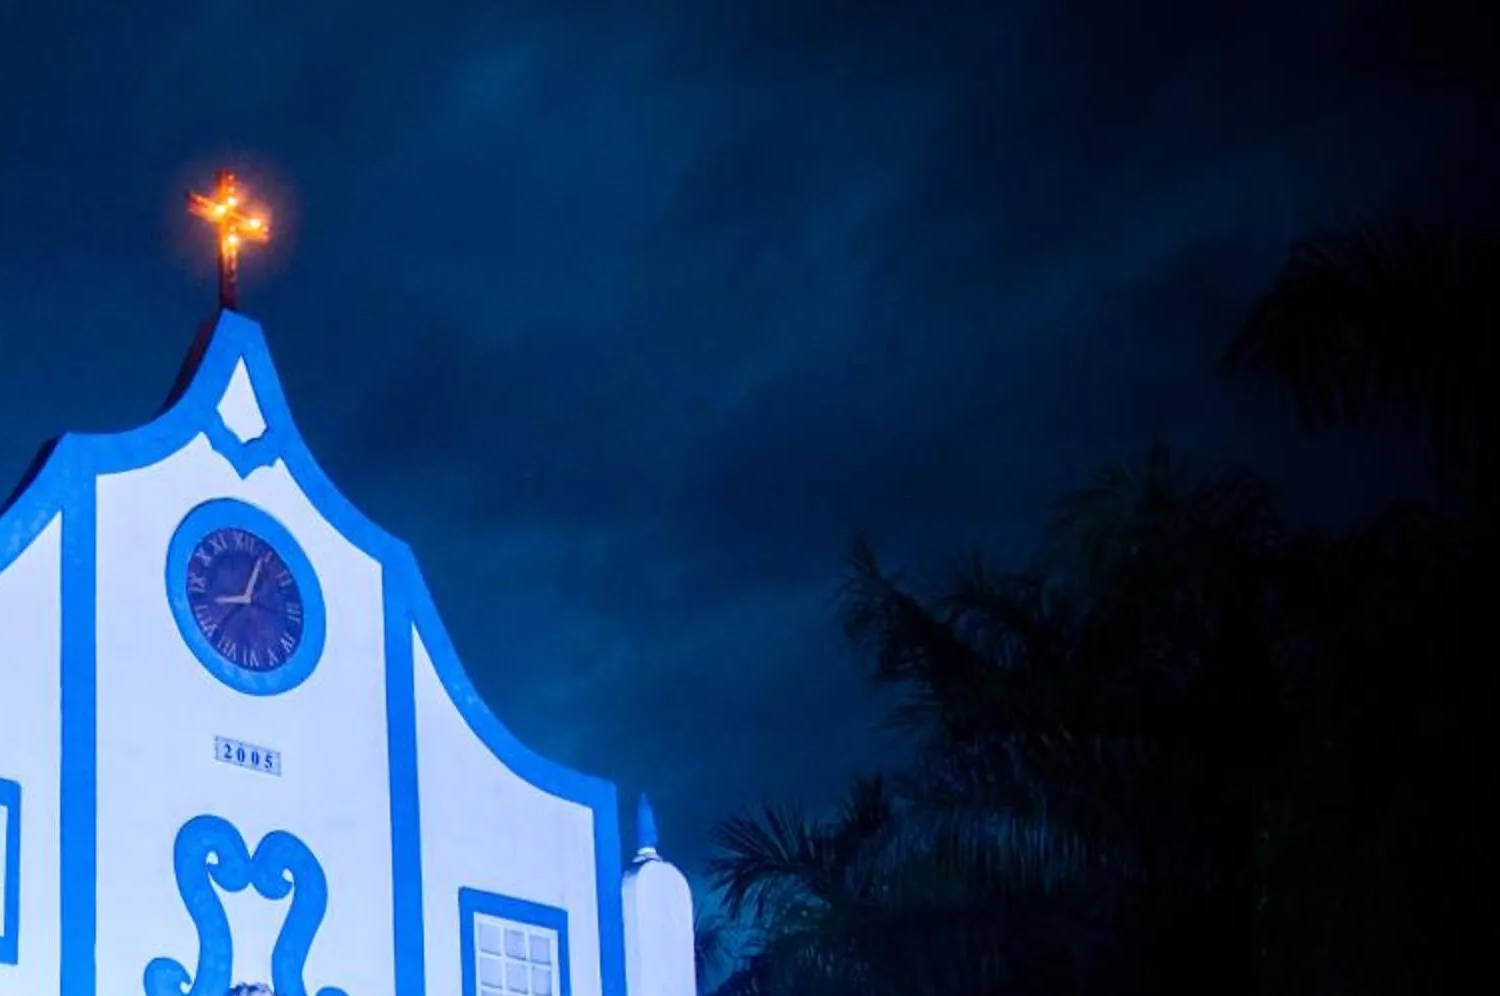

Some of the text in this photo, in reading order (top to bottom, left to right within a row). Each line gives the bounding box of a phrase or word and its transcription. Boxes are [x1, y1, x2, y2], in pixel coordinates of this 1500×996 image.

[207, 533, 228, 555] XI
[195, 547, 212, 567] X
[188, 573, 207, 594] IX
[285, 602, 301, 624] III
[216, 632, 238, 662] VII
[279, 631, 297, 653] IV
[242, 648, 260, 667] VI
[223, 742, 273, 769] 2005
